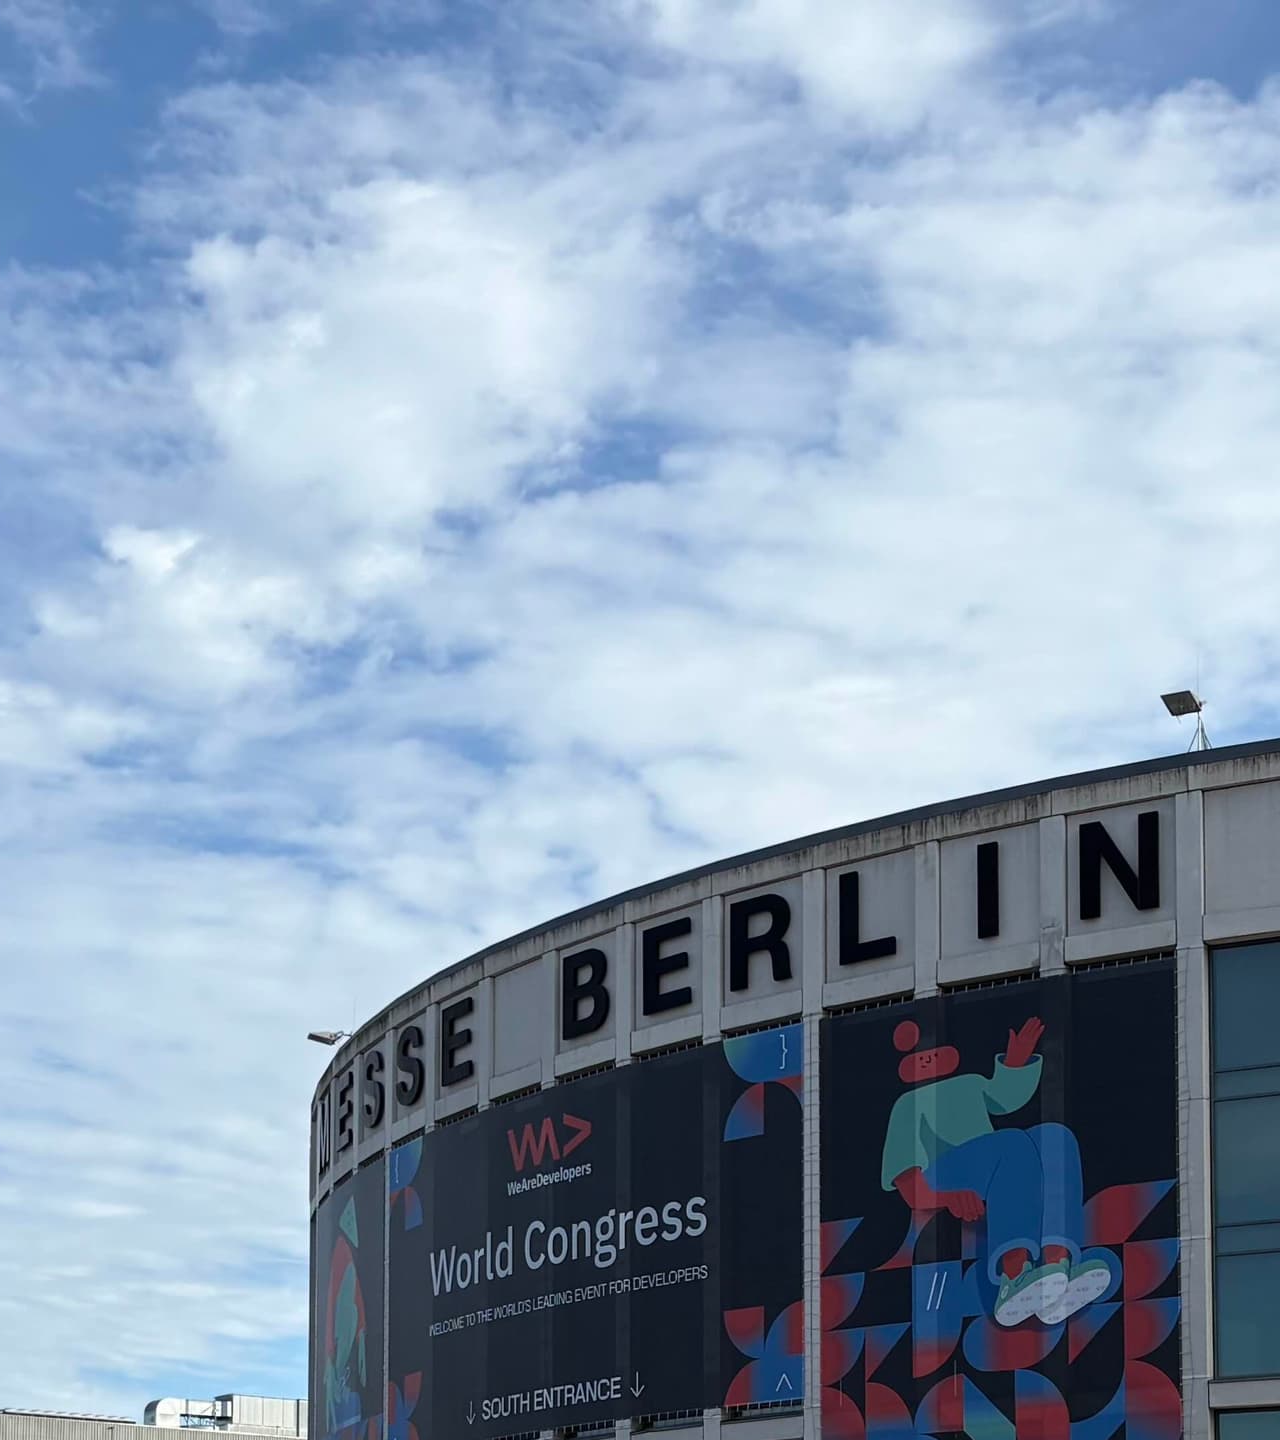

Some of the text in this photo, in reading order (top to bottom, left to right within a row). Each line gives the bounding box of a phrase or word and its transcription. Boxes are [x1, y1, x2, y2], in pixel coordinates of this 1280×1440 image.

[319, 811, 1161, 1177] MESSE BERLIN
[507, 1163, 592, 1196] WeAreDevelopers
[430, 1196, 708, 1297] World Congress
[429, 1265, 709, 1336] WELCOME TO THE WORLD'S LEADING EVENT FOR DEVELOPERS
[482, 1377, 621, 1421] SOUTH ENTRANCE
